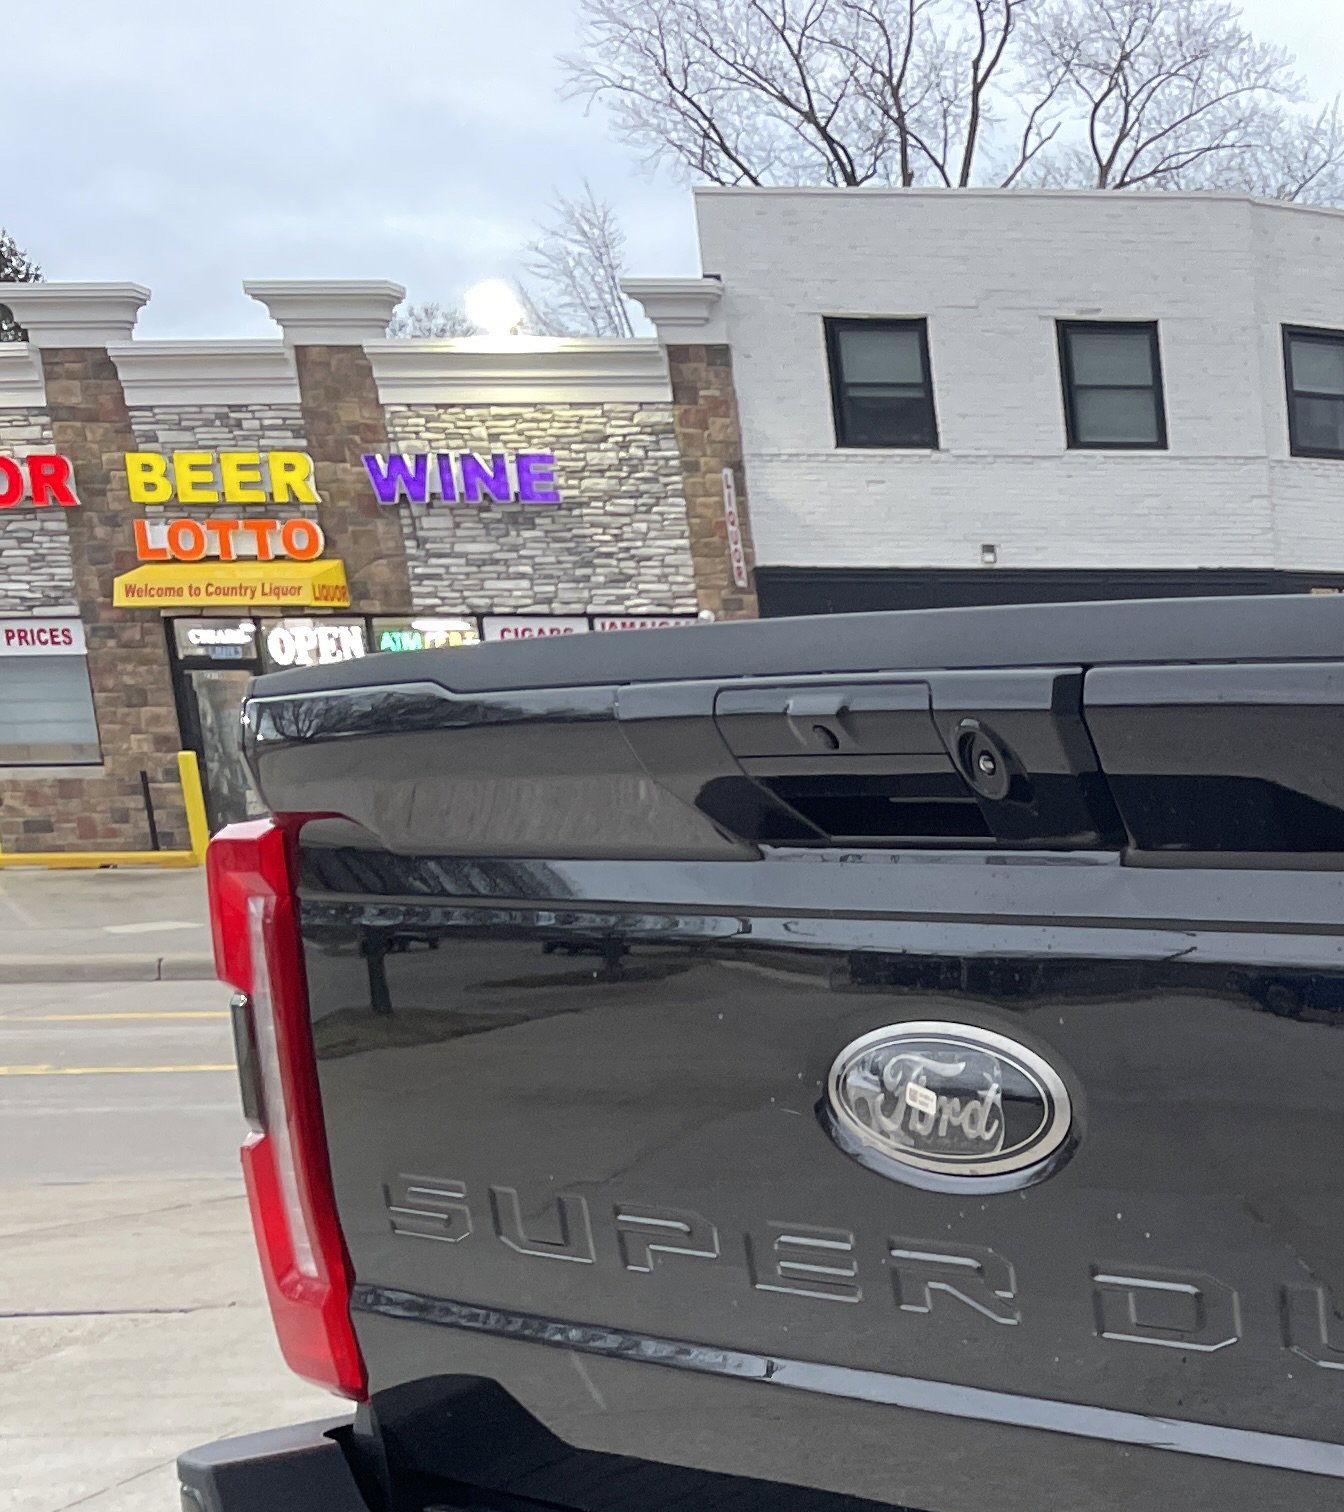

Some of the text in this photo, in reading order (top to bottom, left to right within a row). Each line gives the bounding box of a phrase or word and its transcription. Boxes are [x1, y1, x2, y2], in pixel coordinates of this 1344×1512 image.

[124, 451, 321, 503] BEER
[361, 452, 561, 504] WINE
[133, 519, 325, 561] LOTTO
[124, 582, 303, 600] Welcome to Country Liquor
[5, 628, 73, 646] PRICES
[267, 624, 365, 667] OPEN
[380, 631, 423, 652] ATM
[852, 1053, 1001, 1146] Ford
[384, 1173, 1023, 1327] SUPER
